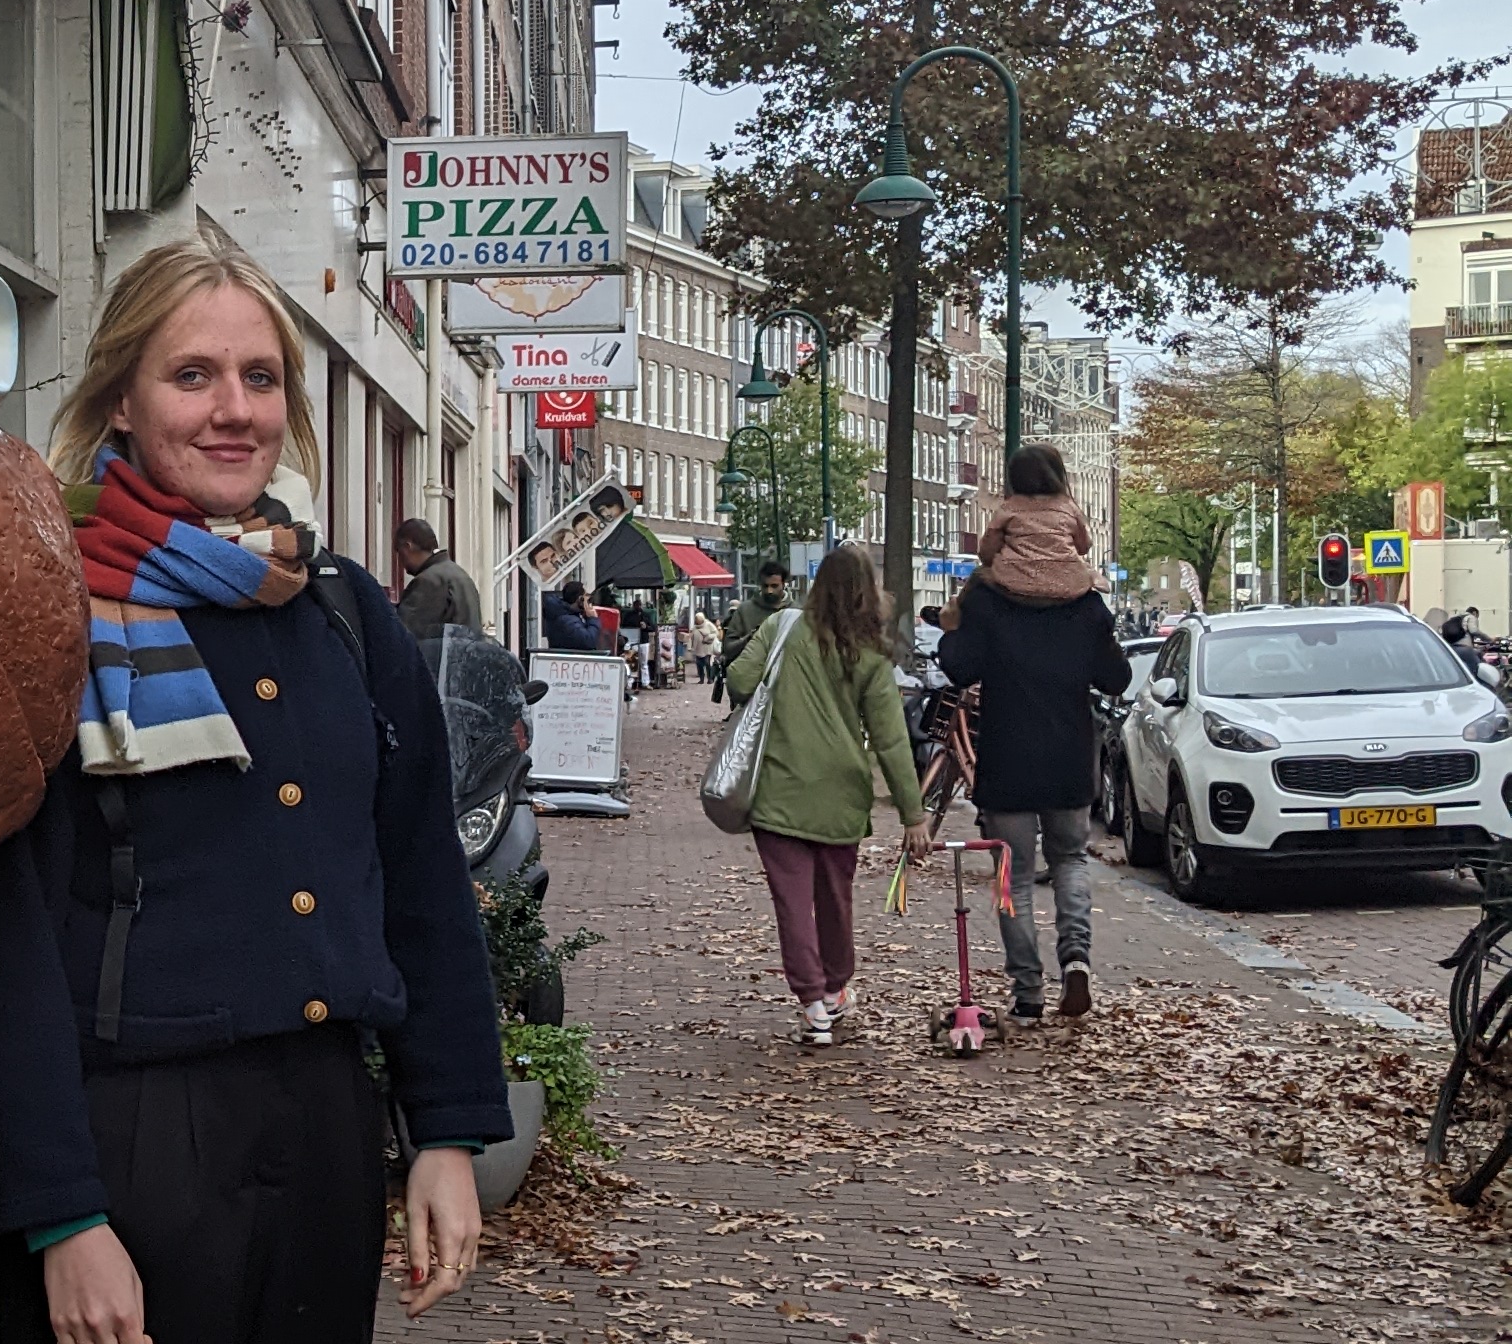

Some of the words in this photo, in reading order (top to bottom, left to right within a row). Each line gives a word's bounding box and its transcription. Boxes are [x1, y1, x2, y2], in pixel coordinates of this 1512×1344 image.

[403, 150, 610, 188] JOHNNY'S
[401, 196, 609, 238] PIZZA
[512, 344, 568, 367] Tina
[512, 374, 555, 386] dames
[559, 374, 567, 385] &
[571, 373, 608, 385] heren
[544, 412, 587, 423] Kruidvat
[550, 513, 614, 570] haarmode
[549, 661, 605, 681] ARGAN
[1366, 743, 1385, 751] KIA
[1346, 808, 1427, 825] JG-770-G
